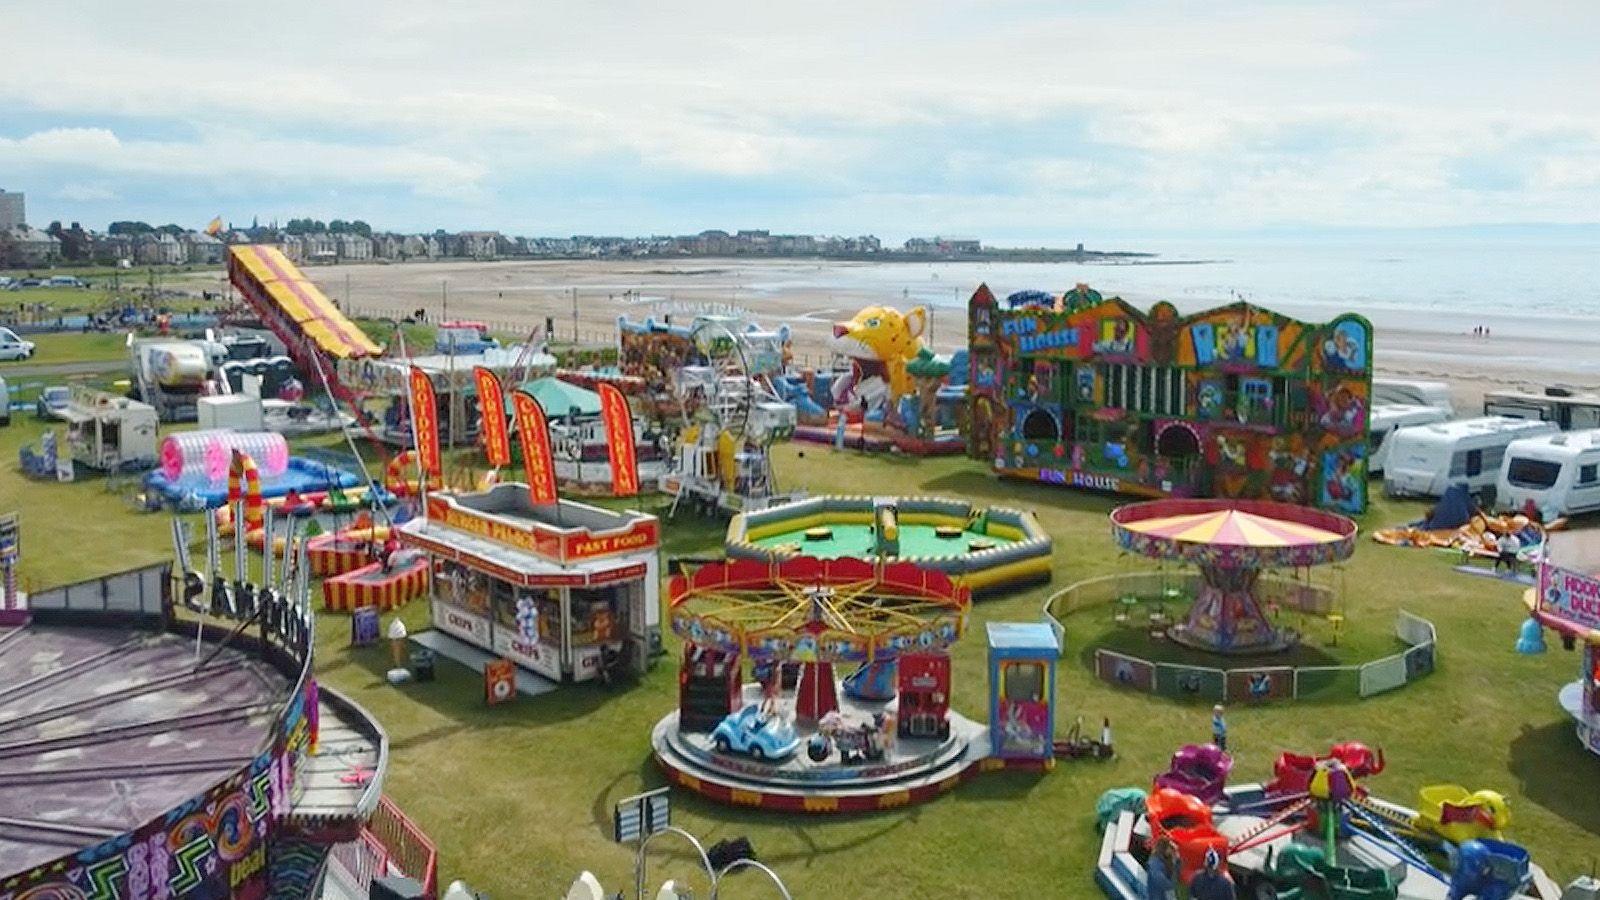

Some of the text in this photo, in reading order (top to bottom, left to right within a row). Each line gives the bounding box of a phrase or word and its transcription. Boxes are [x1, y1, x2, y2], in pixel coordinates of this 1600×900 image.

[1002, 317, 1037, 336] FUN
[1020, 328, 1079, 352] HOUSE
[1040, 468, 1120, 491] FUN HOUSE
[575, 533, 648, 555] FAST FOOD
